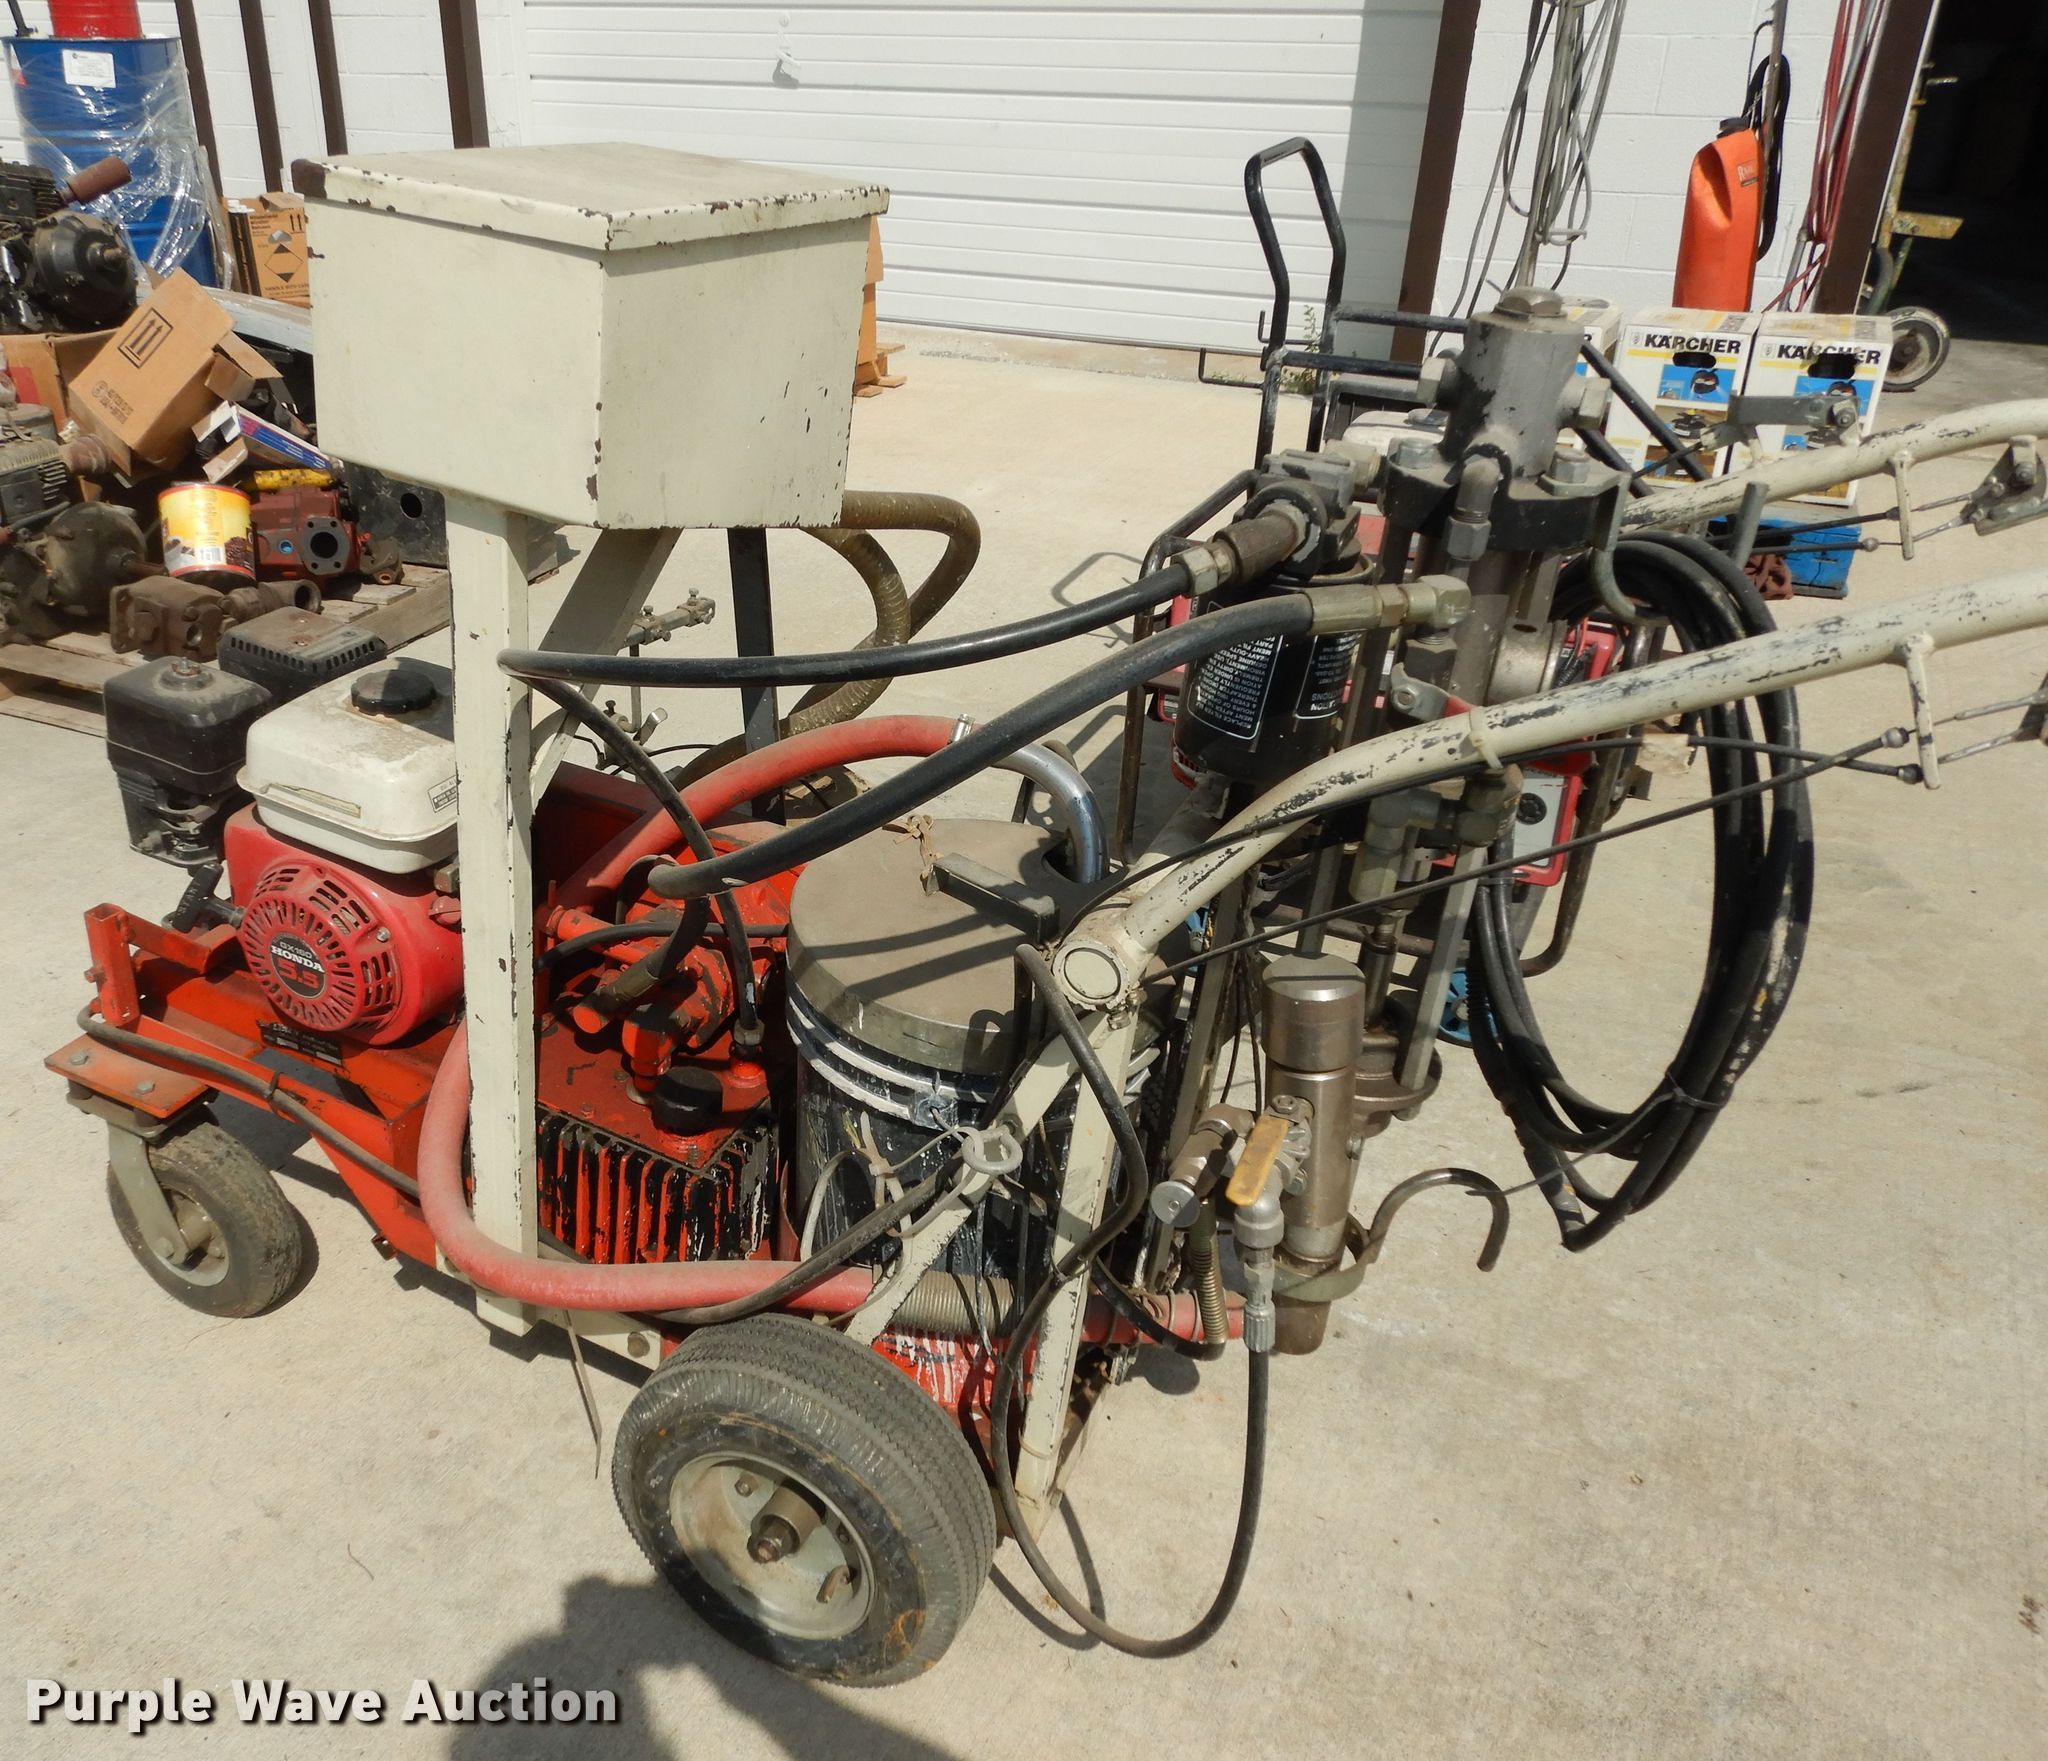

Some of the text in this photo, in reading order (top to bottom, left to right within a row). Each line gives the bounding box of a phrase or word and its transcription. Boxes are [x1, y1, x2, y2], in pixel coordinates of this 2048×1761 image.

[1220, 678, 1260, 695] FREQUENTLY
[270, 944, 325, 974] HONDA
[277, 957, 320, 989] 5.5
